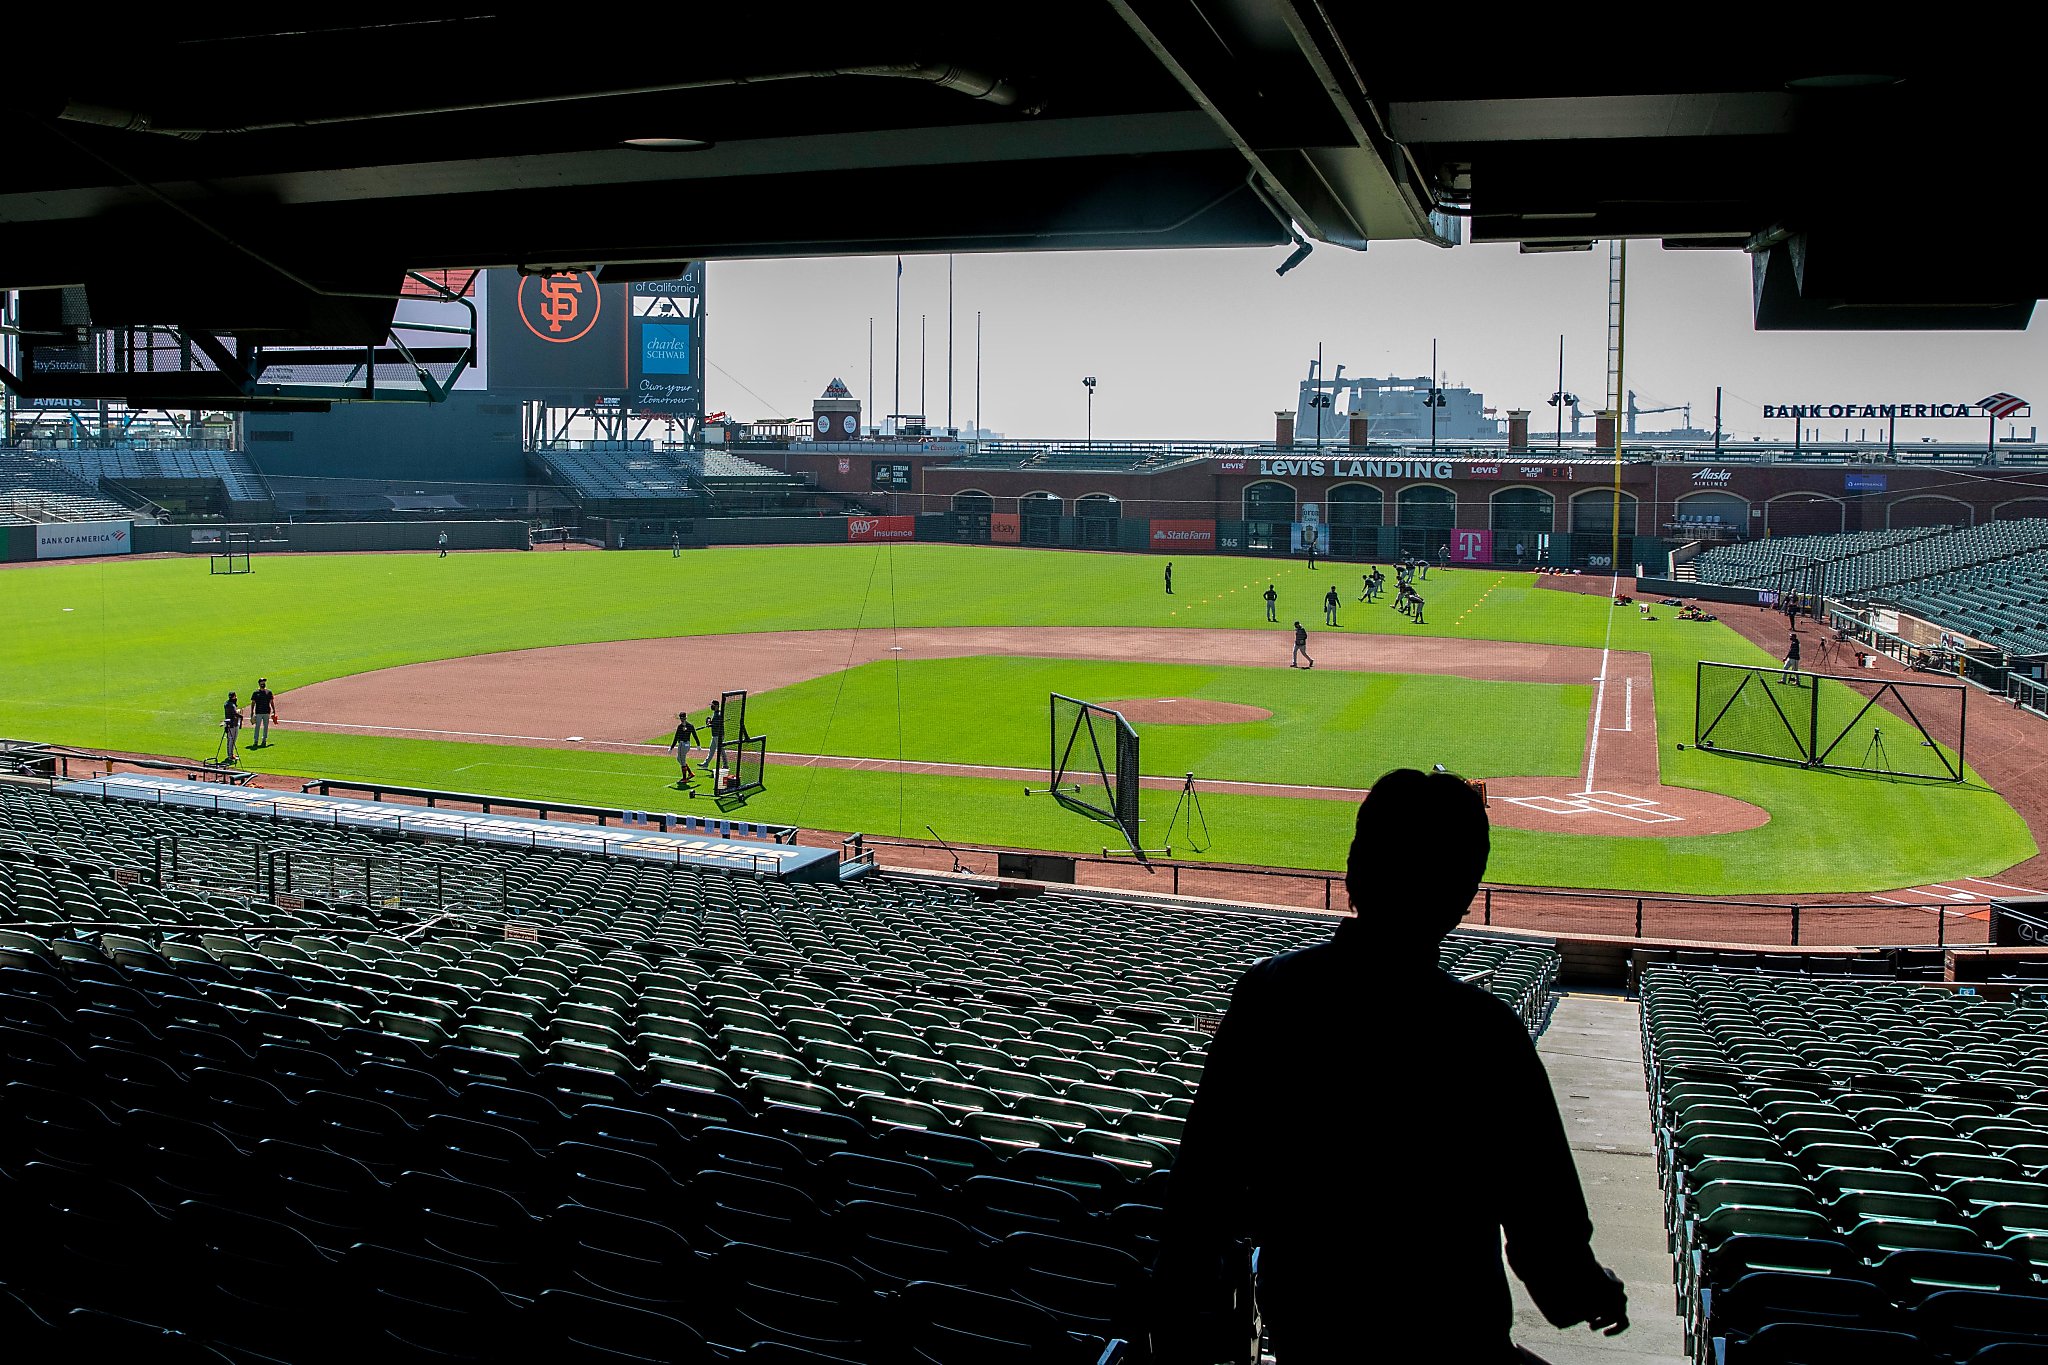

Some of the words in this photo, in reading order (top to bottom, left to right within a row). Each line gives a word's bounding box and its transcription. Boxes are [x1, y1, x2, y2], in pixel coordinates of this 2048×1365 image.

[635, 282, 646, 292] of
[648, 282, 696, 293] California
[647, 337, 685, 350] charles
[646, 350, 686, 359] SCHWAB
[639, 379, 664, 391] Own
[664, 384, 693, 397] your
[638, 393, 695, 404] tomorrow
[1763, 404, 1822, 418] BANK
[1828, 404, 1858, 418] OF
[1862, 403, 1970, 418] AMERICA
[1333, 460, 1453, 479] LANDING
[1691, 467, 1731, 481] Alaska
[873, 529, 913, 538] Insurance
[992, 520, 1016, 536] ebay
[41, 536, 63, 546] BANK
[64, 536, 75, 545] OF
[75, 534, 111, 544] AMERICA
[1221, 538, 1238, 547] 365
[1589, 555, 1611, 567] 309
[1758, 591, 1779, 604] KNBR
